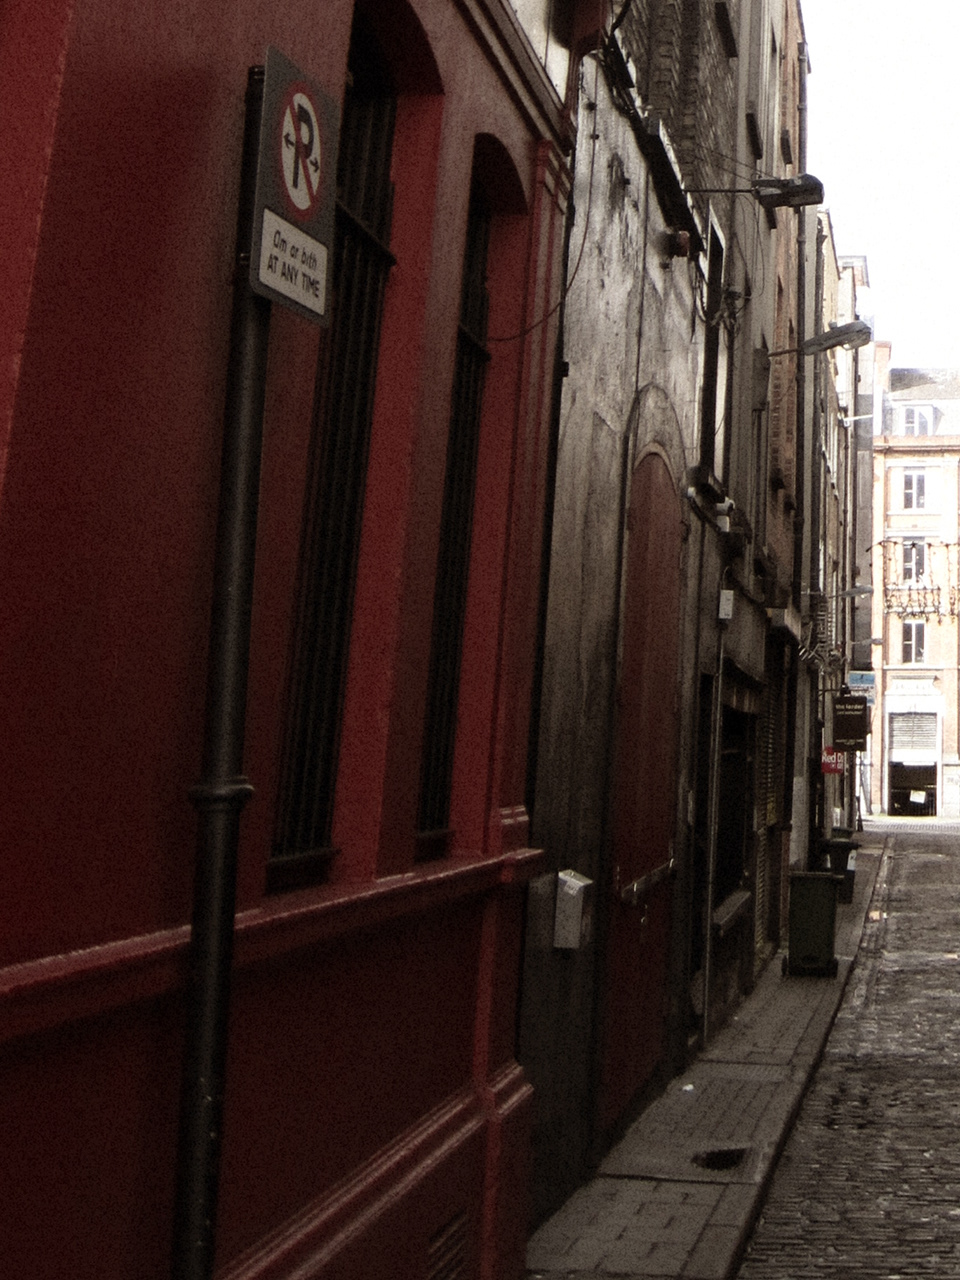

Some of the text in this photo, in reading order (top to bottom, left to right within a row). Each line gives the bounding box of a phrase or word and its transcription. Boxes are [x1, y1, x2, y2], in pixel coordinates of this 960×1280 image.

[267, 253, 320, 299] AT ANY TIME
